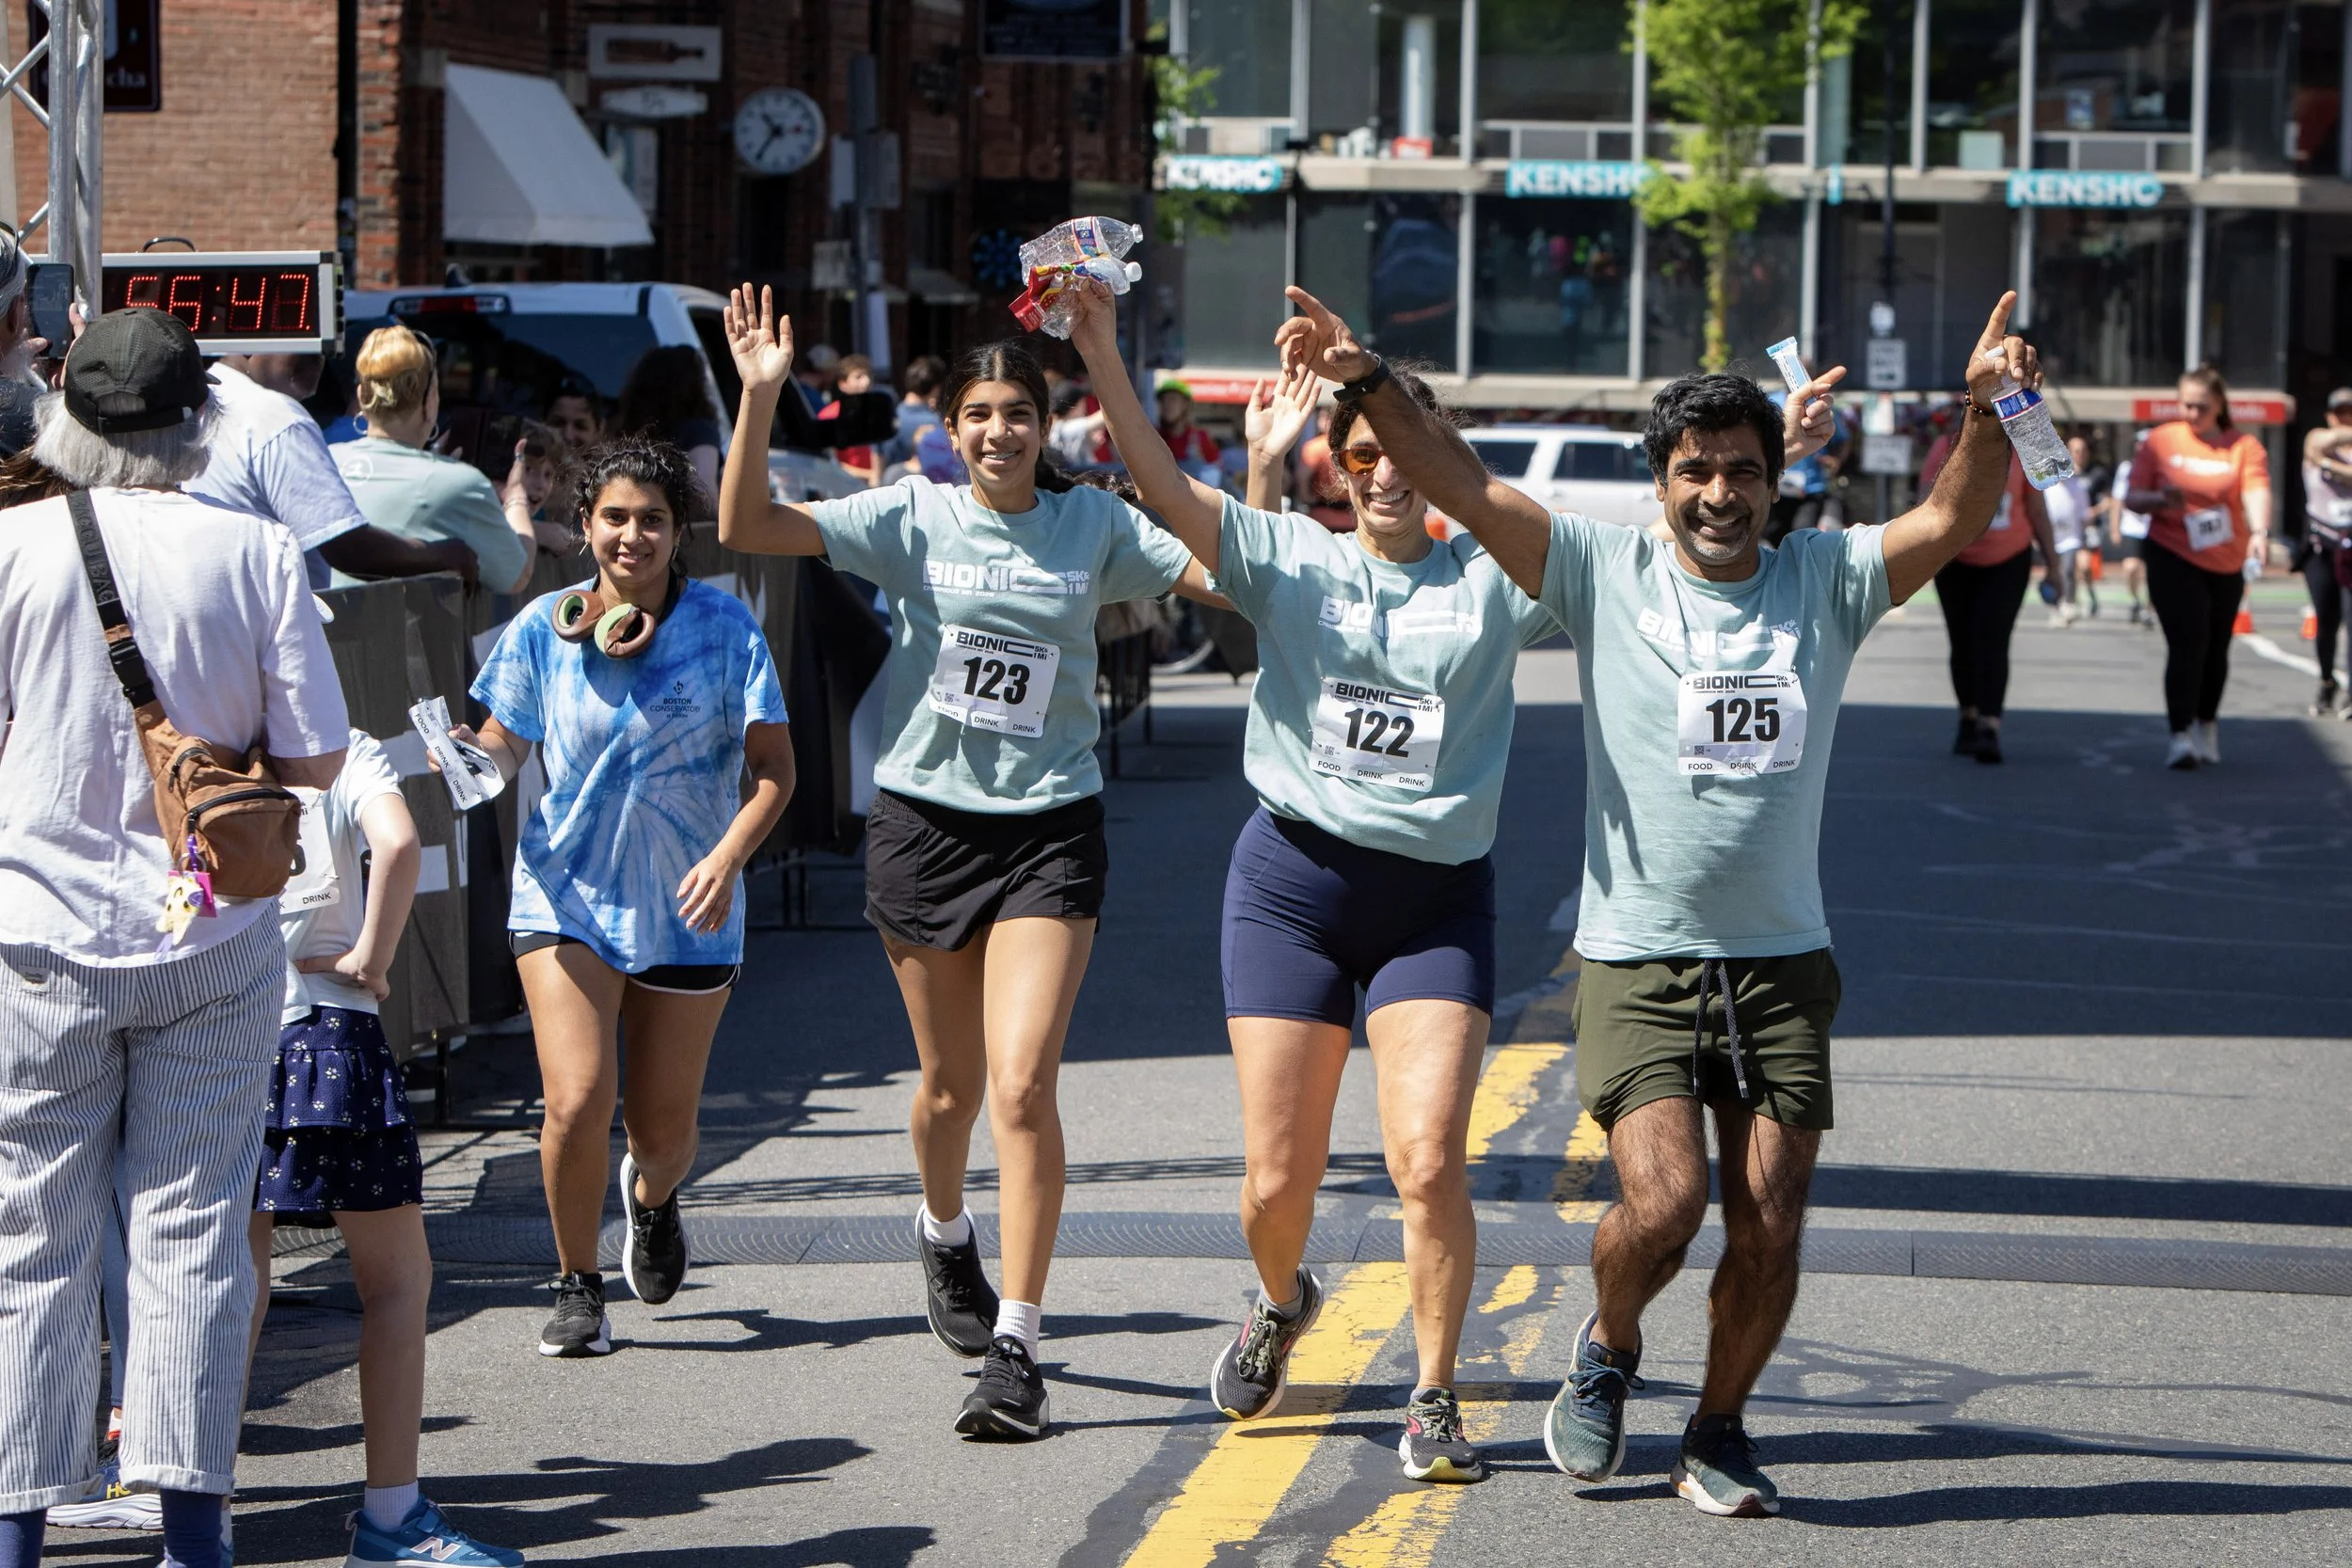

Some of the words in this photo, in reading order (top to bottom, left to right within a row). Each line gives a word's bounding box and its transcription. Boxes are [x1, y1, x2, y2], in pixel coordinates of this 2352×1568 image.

[2011, 172, 2161, 207] KENSHO
[922, 560, 1068, 594] BIONIC
[956, 631, 1035, 657] BIONIC
[963, 656, 1030, 705] 123
[1693, 675, 1777, 689] BIONIC
[1336, 682, 1420, 709] BIONIC
[974, 716, 999, 727] DRINK
[1012, 723, 1036, 734] DRINK
[1344, 707, 1414, 758] 122
[1706, 697, 1780, 743] 125
[415, 713, 430, 734] FOOD
[435, 746, 451, 768] DRINK
[453, 780, 468, 802] DRINK
[1730, 762, 1757, 770] DRINK
[1772, 759, 1796, 768] DRINK
[1317, 760, 1342, 771] FOOD
[1357, 769, 1383, 780] DRINK
[1399, 776, 1425, 787] DRINK
[302, 892, 331, 904] DRINK
